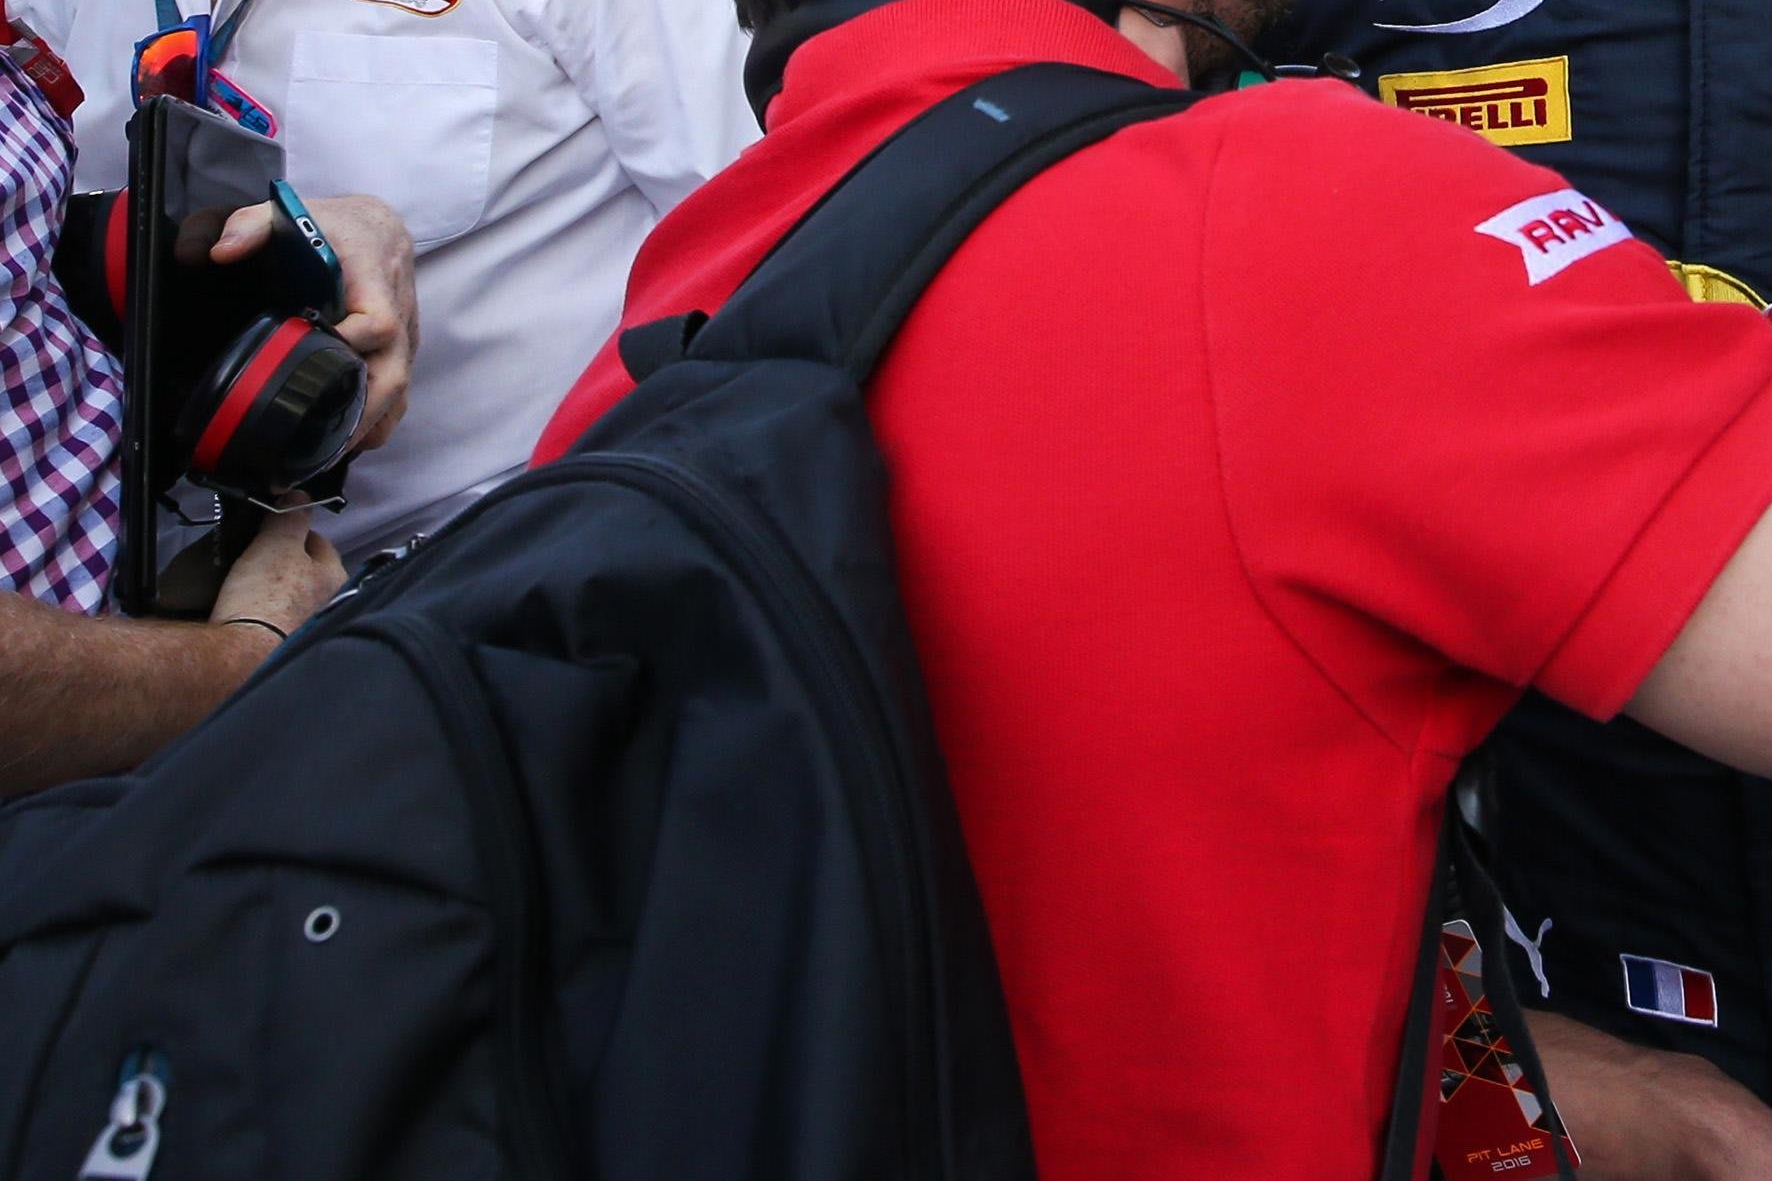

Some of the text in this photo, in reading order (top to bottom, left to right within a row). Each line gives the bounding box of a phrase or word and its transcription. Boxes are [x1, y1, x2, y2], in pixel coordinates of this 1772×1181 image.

[1467, 1138, 1545, 1164] PIT LANE
[1491, 1155, 1532, 1172] 2016
